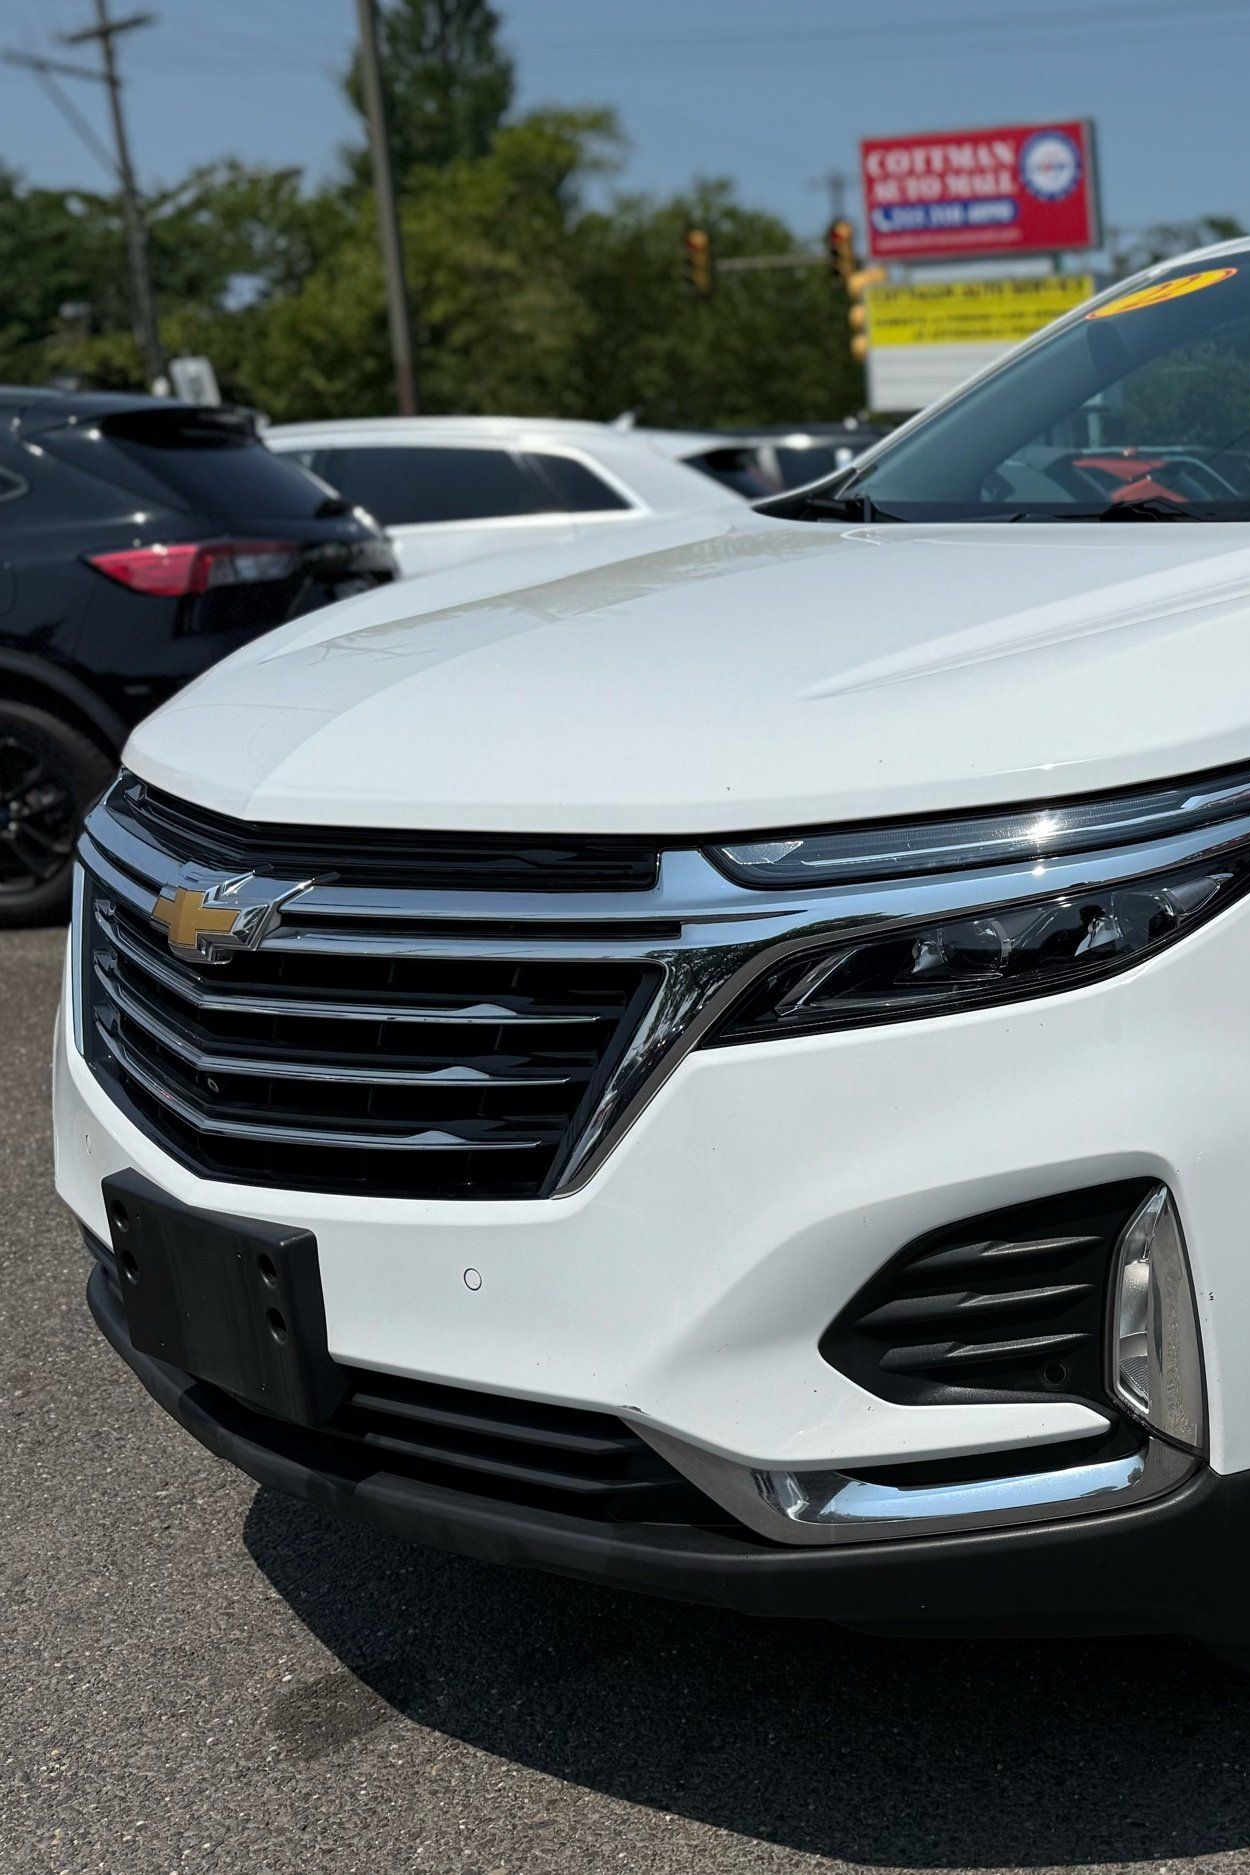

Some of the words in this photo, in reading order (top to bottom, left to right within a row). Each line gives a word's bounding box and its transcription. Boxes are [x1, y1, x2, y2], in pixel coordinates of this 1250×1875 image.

[866, 140, 1015, 177] COTTMAN
[874, 175, 942, 201] AUTO
[946, 170, 1014, 197] MALL
